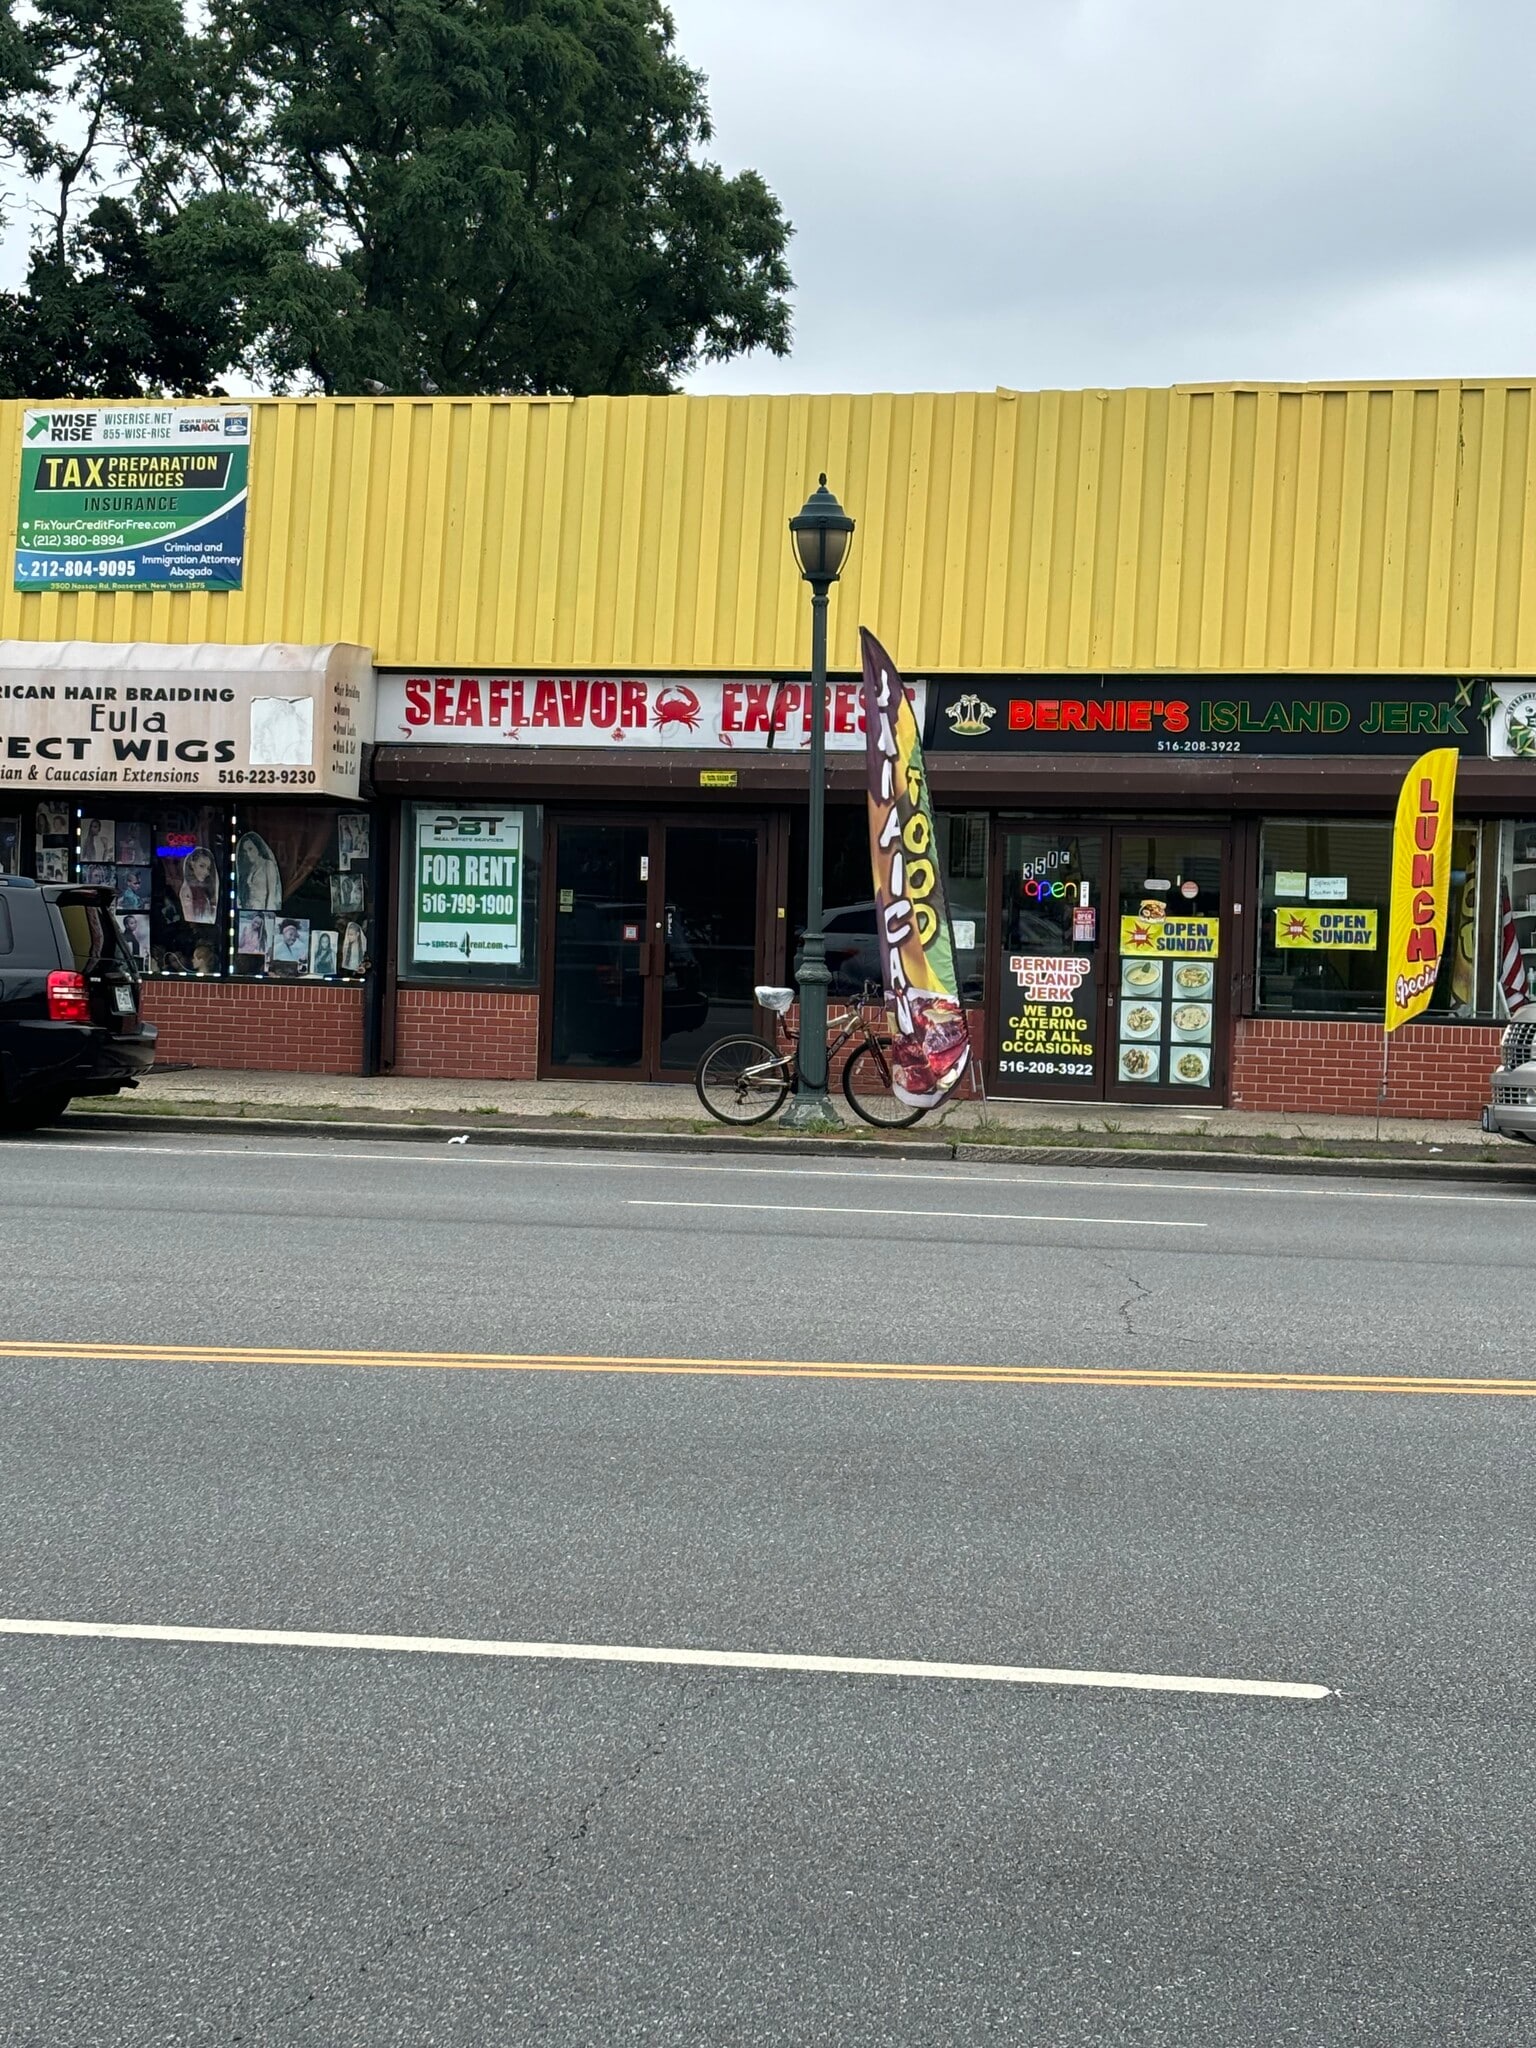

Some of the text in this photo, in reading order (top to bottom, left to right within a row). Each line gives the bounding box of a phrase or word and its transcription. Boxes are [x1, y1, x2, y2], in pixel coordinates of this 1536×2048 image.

[51, 413, 97, 428] WISE
[104, 412, 173, 425] WISERISE.NET
[51, 428, 93, 442] RISE
[102, 427, 172, 440] 855-WISE-RISE
[179, 423, 220, 433] ESPAÑOL
[108, 455, 218, 472] PREPARATION
[45, 457, 105, 488] TAX
[107, 472, 185, 488] SERVICES
[84, 496, 178, 512] INSURANCE
[33, 519, 177, 531] FixYourCreditForFree.com
[32, 534, 125, 547] (212) 380-8994
[164, 542, 223, 553] Criminal and
[30, 560, 136, 577] 212-804-9095
[142, 553, 242, 568] Immigration Attorney
[169, 566, 213, 579] Abogado
[0, 685, 236, 702] ICAN HAIR BRAIDING
[721, 683, 916, 734] EXPRE
[1007, 699, 1190, 733] BERNIE'S
[1200, 700, 1350, 733] ISLAND
[1359, 701, 1469, 734] JERK
[90, 703, 169, 733] Eula
[0, 736, 236, 763] ECT WIGS
[1157, 740, 1241, 752] 516-208-3922
[27, 764, 39, 781] &
[45, 766, 118, 782] Caucasian
[122, 767, 200, 784] Extensions
[218, 769, 317, 785] 516-223-9230
[434, 816, 505, 836] PBT
[422, 854, 517, 887] FOR RENT
[1406, 778, 1439, 963] LUNCH
[1024, 880, 1078, 902] open
[422, 893, 514, 916] 516-799-1900
[1163, 922, 1209, 937] OPEN
[1319, 914, 1367, 929] OPEN
[1156, 937, 1215, 953] SUNDAY
[1312, 929, 1373, 945] SUNDAY
[1010, 957, 1090, 974] BERNIE'S
[1018, 972, 1081, 987] ISLAND
[1025, 986, 1073, 1001] JERK
[1023, 1004, 1074, 1018] WE DO
[1008, 1016, 1089, 1031] CATERING
[1015, 1029, 1081, 1043] FOR ALL
[1001, 1040, 1094, 1056] OCCASIONS
[999, 1060, 1094, 1076] 516-208-3922
